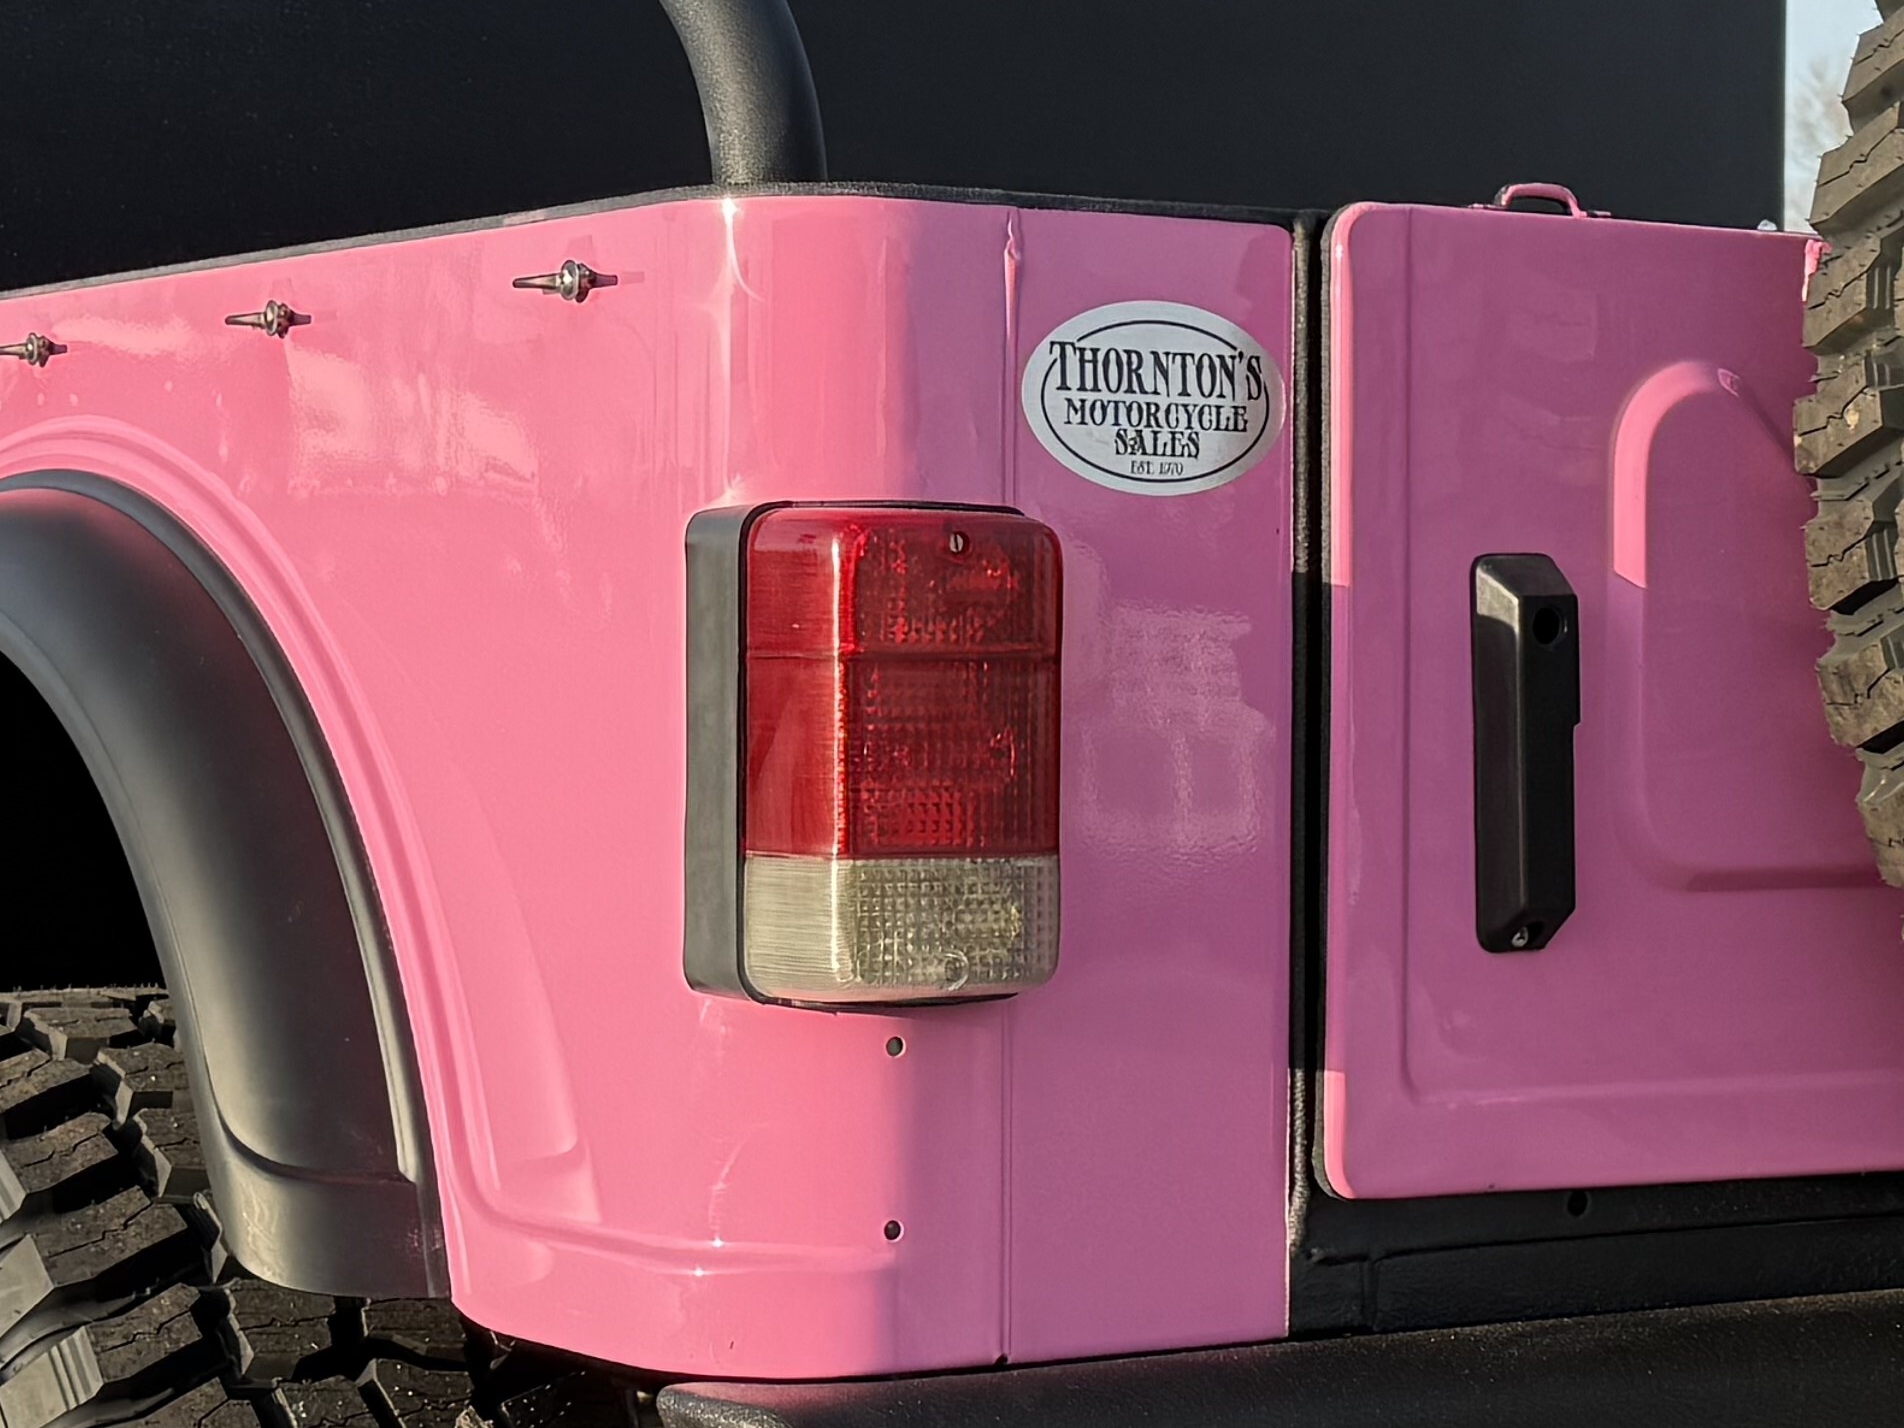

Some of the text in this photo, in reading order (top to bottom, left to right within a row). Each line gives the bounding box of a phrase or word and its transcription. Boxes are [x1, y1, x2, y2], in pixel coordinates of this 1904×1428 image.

[1049, 340, 1263, 401] THORNTON'S
[1064, 397, 1249, 433] MOTORCYCLE
[1114, 427, 1201, 459] SALES
